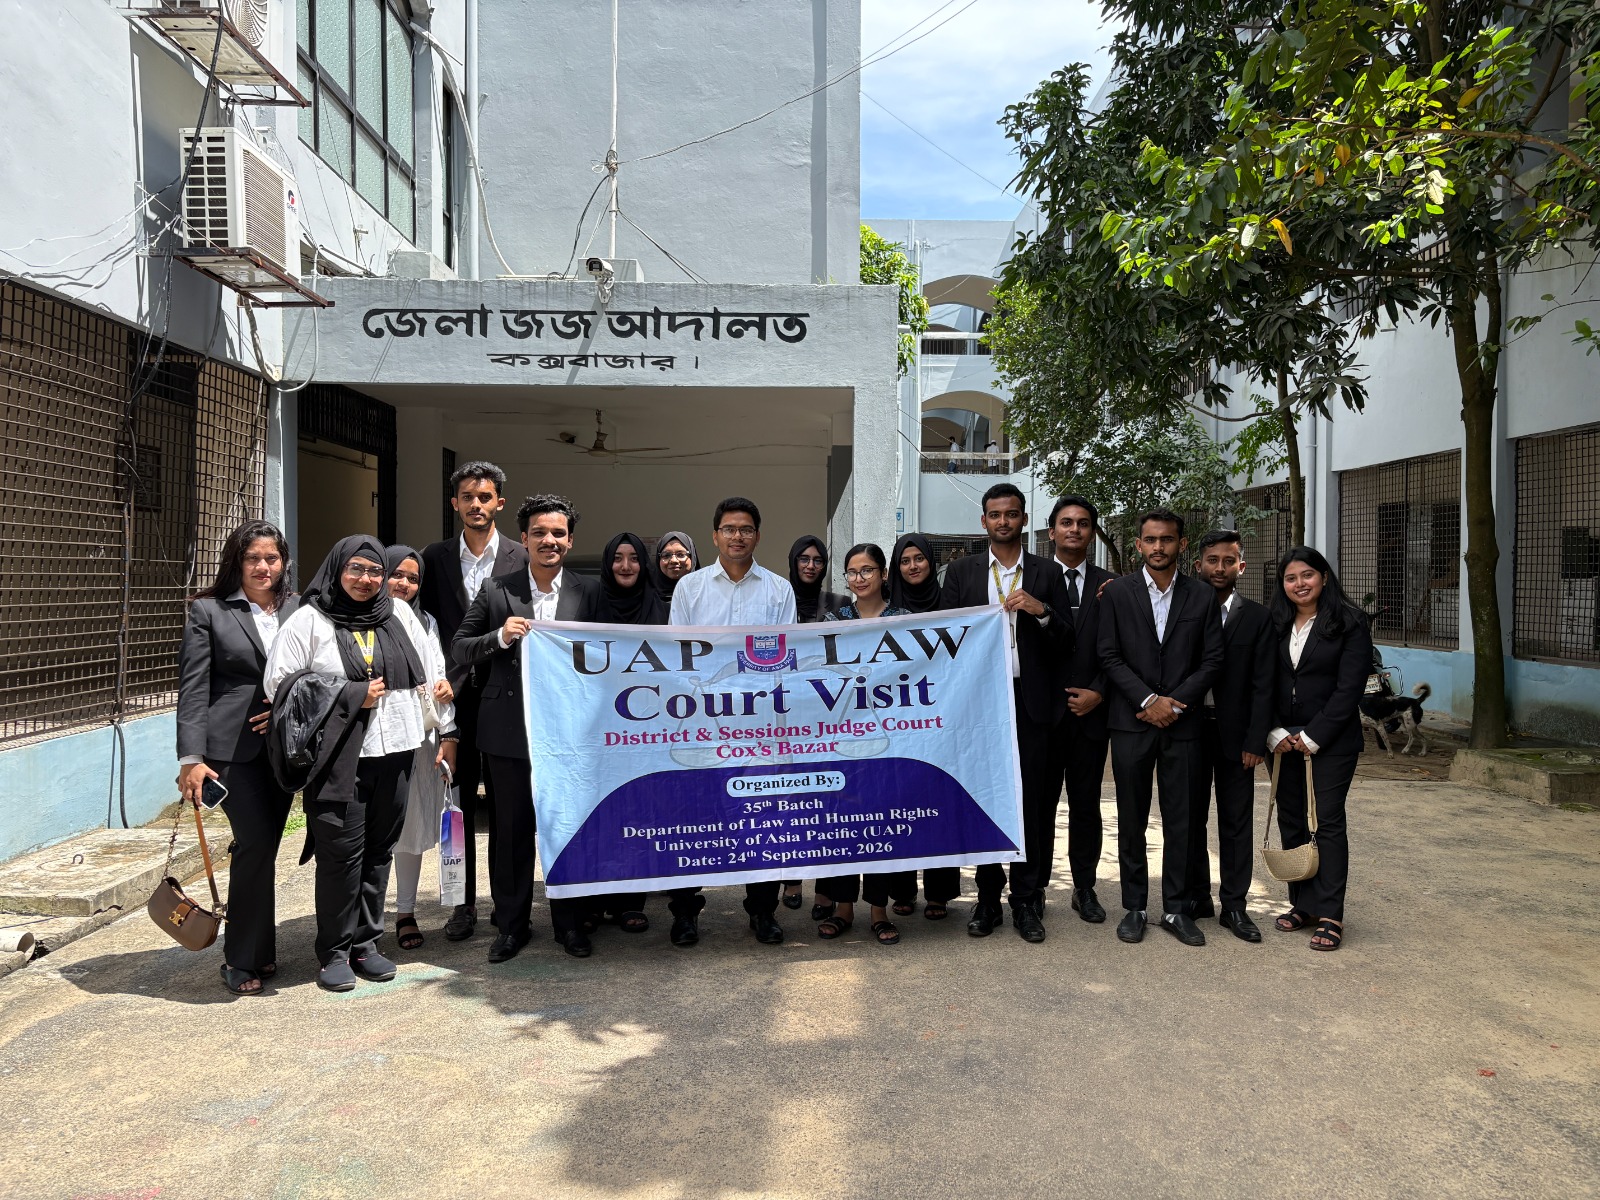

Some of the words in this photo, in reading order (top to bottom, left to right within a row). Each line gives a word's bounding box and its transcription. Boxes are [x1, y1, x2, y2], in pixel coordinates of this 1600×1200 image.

[362, 303, 493, 339] জেলা
[500, 309, 598, 340] জজ
[605, 303, 810, 344] আদালত
[486, 352, 677, 372] কক্সবাজার
[566, 639, 714, 675] UAP
[818, 625, 971, 666] LAW
[614, 684, 791, 720] Court
[806, 673, 936, 712] Visit
[604, 728, 690, 746] District
[695, 727, 712, 742] &
[718, 723, 812, 740] Sessions
[815, 719, 877, 738] Judge
[882, 715, 944, 732] Court
[777, 741, 839, 755] Bazar
[732, 776, 811, 793] Organized
[815, 774, 840, 788] By:
[743, 800, 772, 814] 35th
[777, 798, 824, 812] Batch
[623, 821, 724, 840] Department
[728, 818, 747, 831] of
[750, 818, 785, 829] Law
[790, 814, 820, 827] and
[825, 812, 884, 824] Human
[890, 807, 939, 821] Rights
[655, 837, 740, 852] University
[745, 833, 763, 846] of
[765, 832, 801, 844] Asia
[806, 827, 859, 841] Pacific
[862, 823, 913, 840] (UAP)
[678, 855, 722, 868] Date:
[727, 850, 757, 865] 24th
[762, 846, 852, 863] September,
[856, 841, 893, 855] 2026
